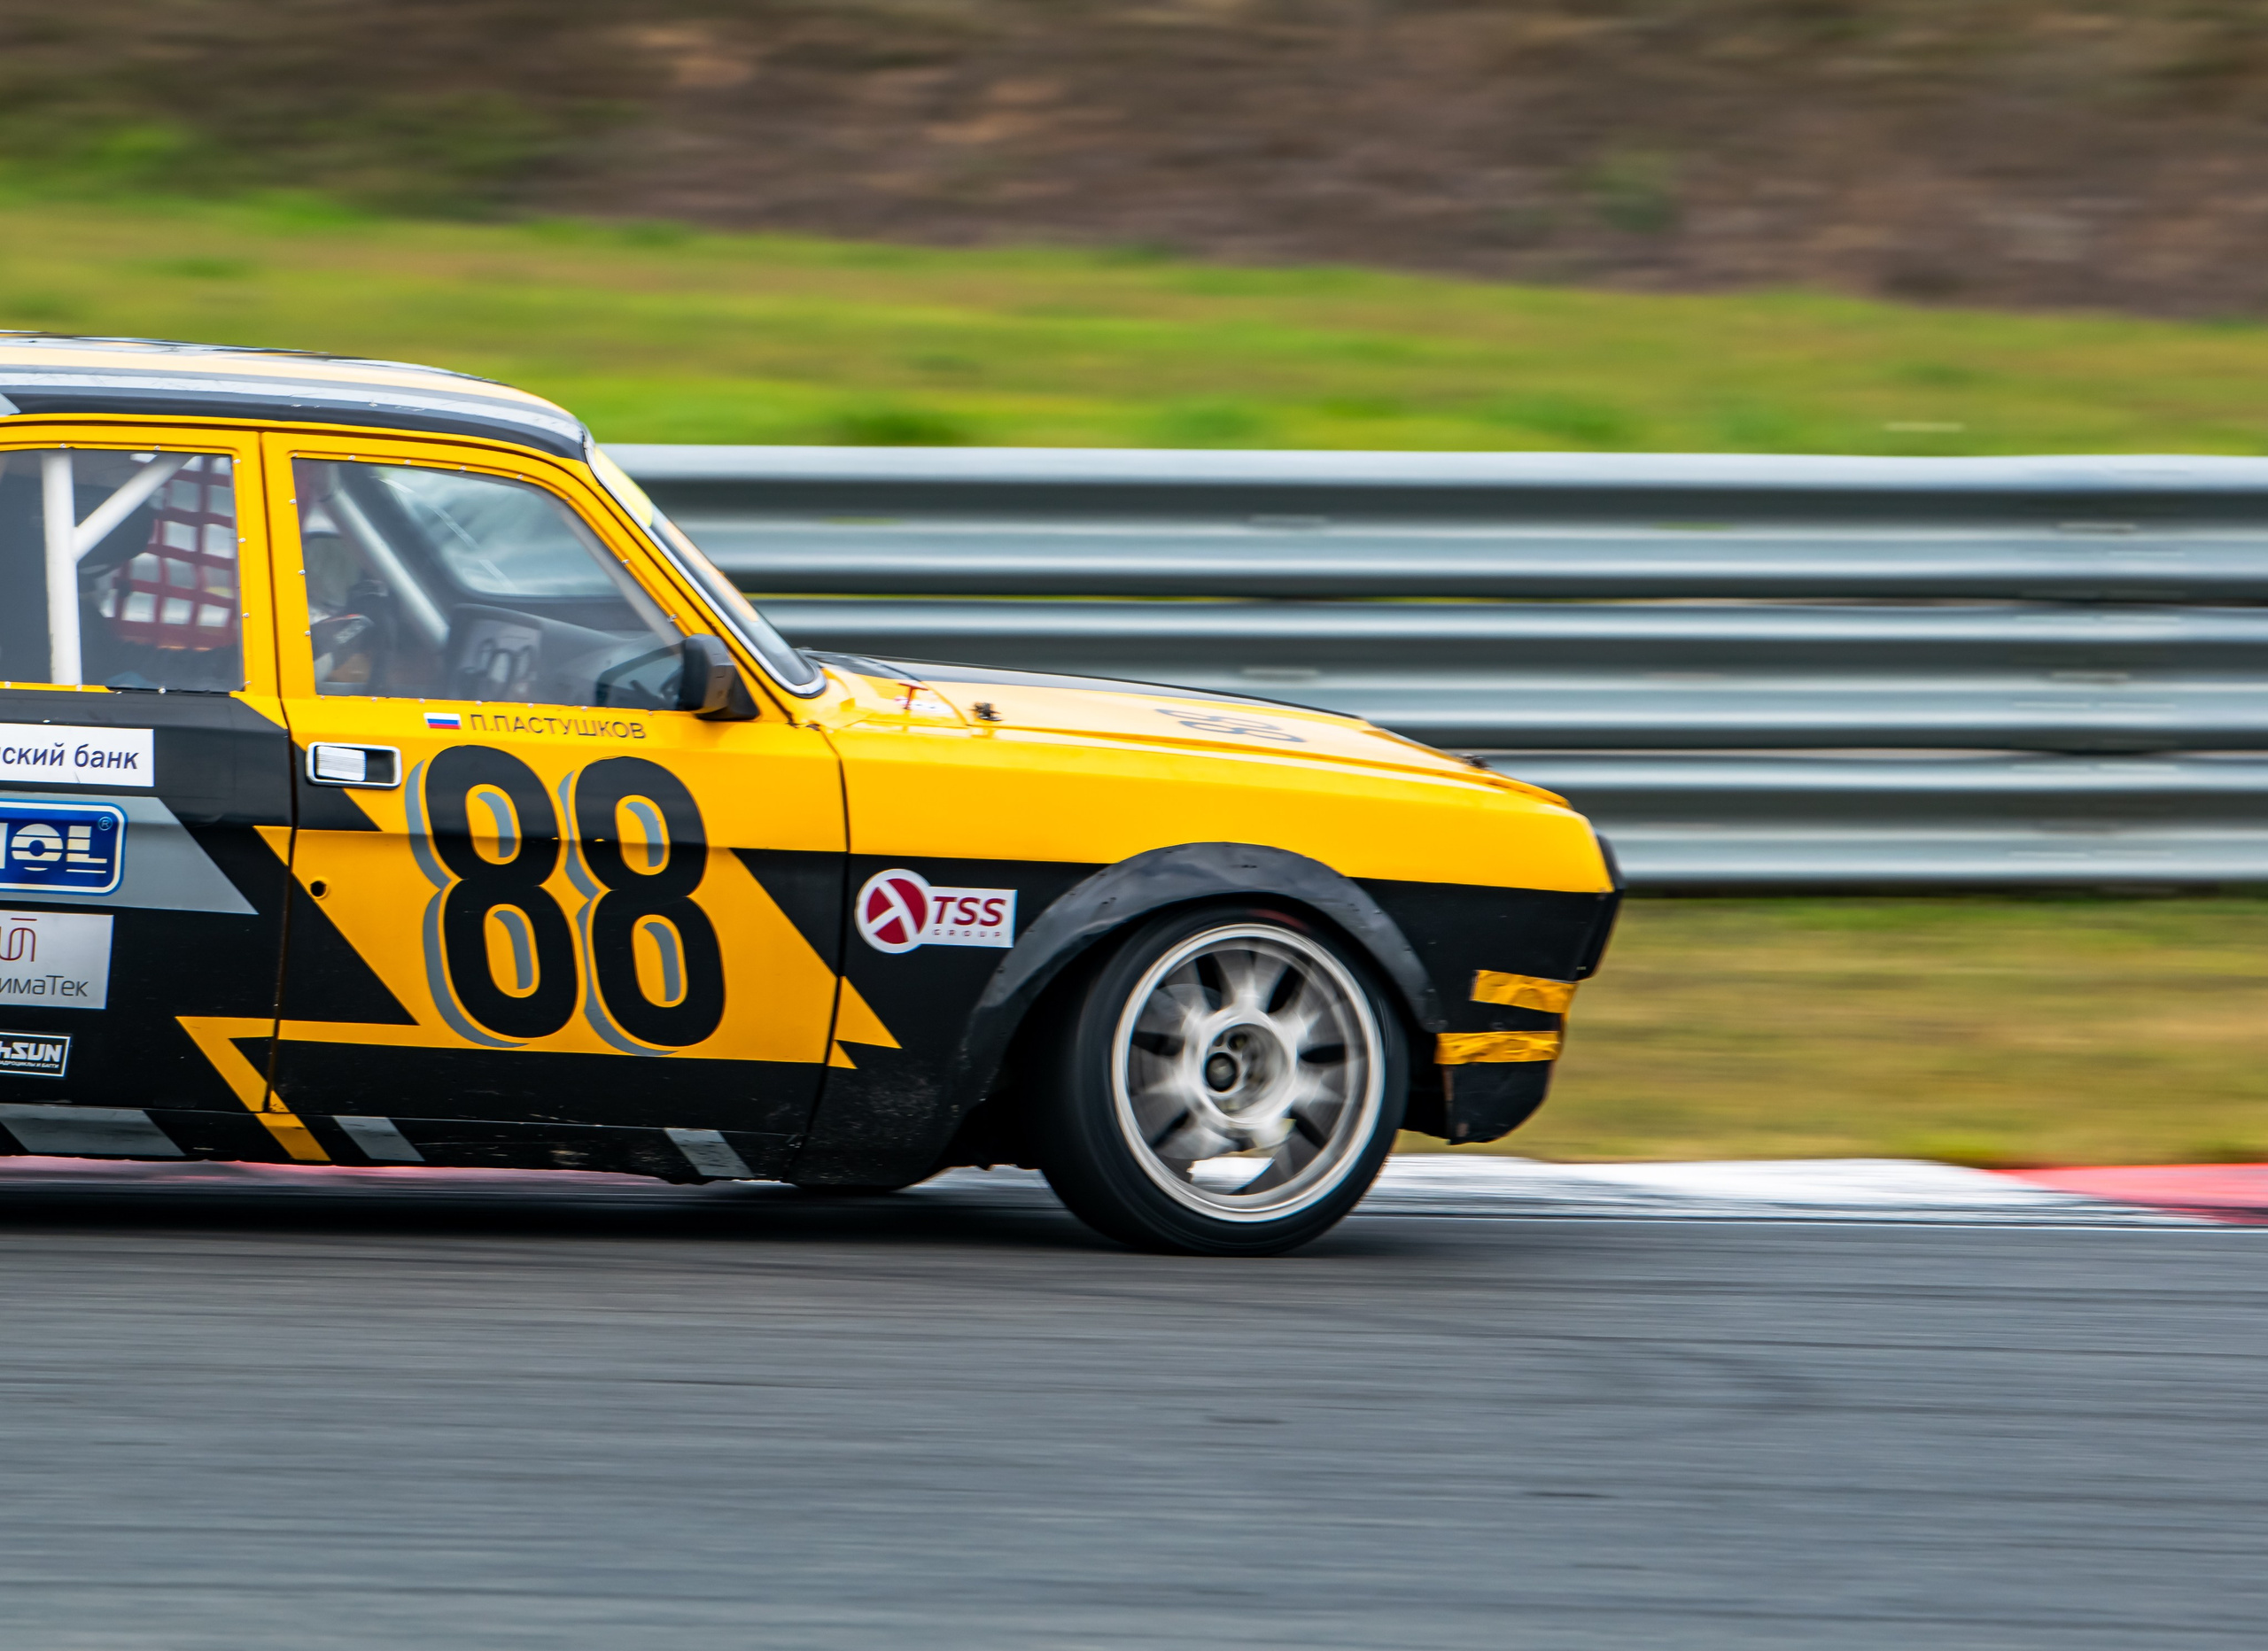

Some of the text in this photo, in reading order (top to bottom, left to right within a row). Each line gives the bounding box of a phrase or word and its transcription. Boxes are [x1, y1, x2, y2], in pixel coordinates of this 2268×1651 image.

[470, 714, 647, 740] П.ПАСТУШКОВ
[0, 742, 140, 770] ский банк
[405, 745, 726, 1056] 88
[932, 895, 1007, 927] TSS
